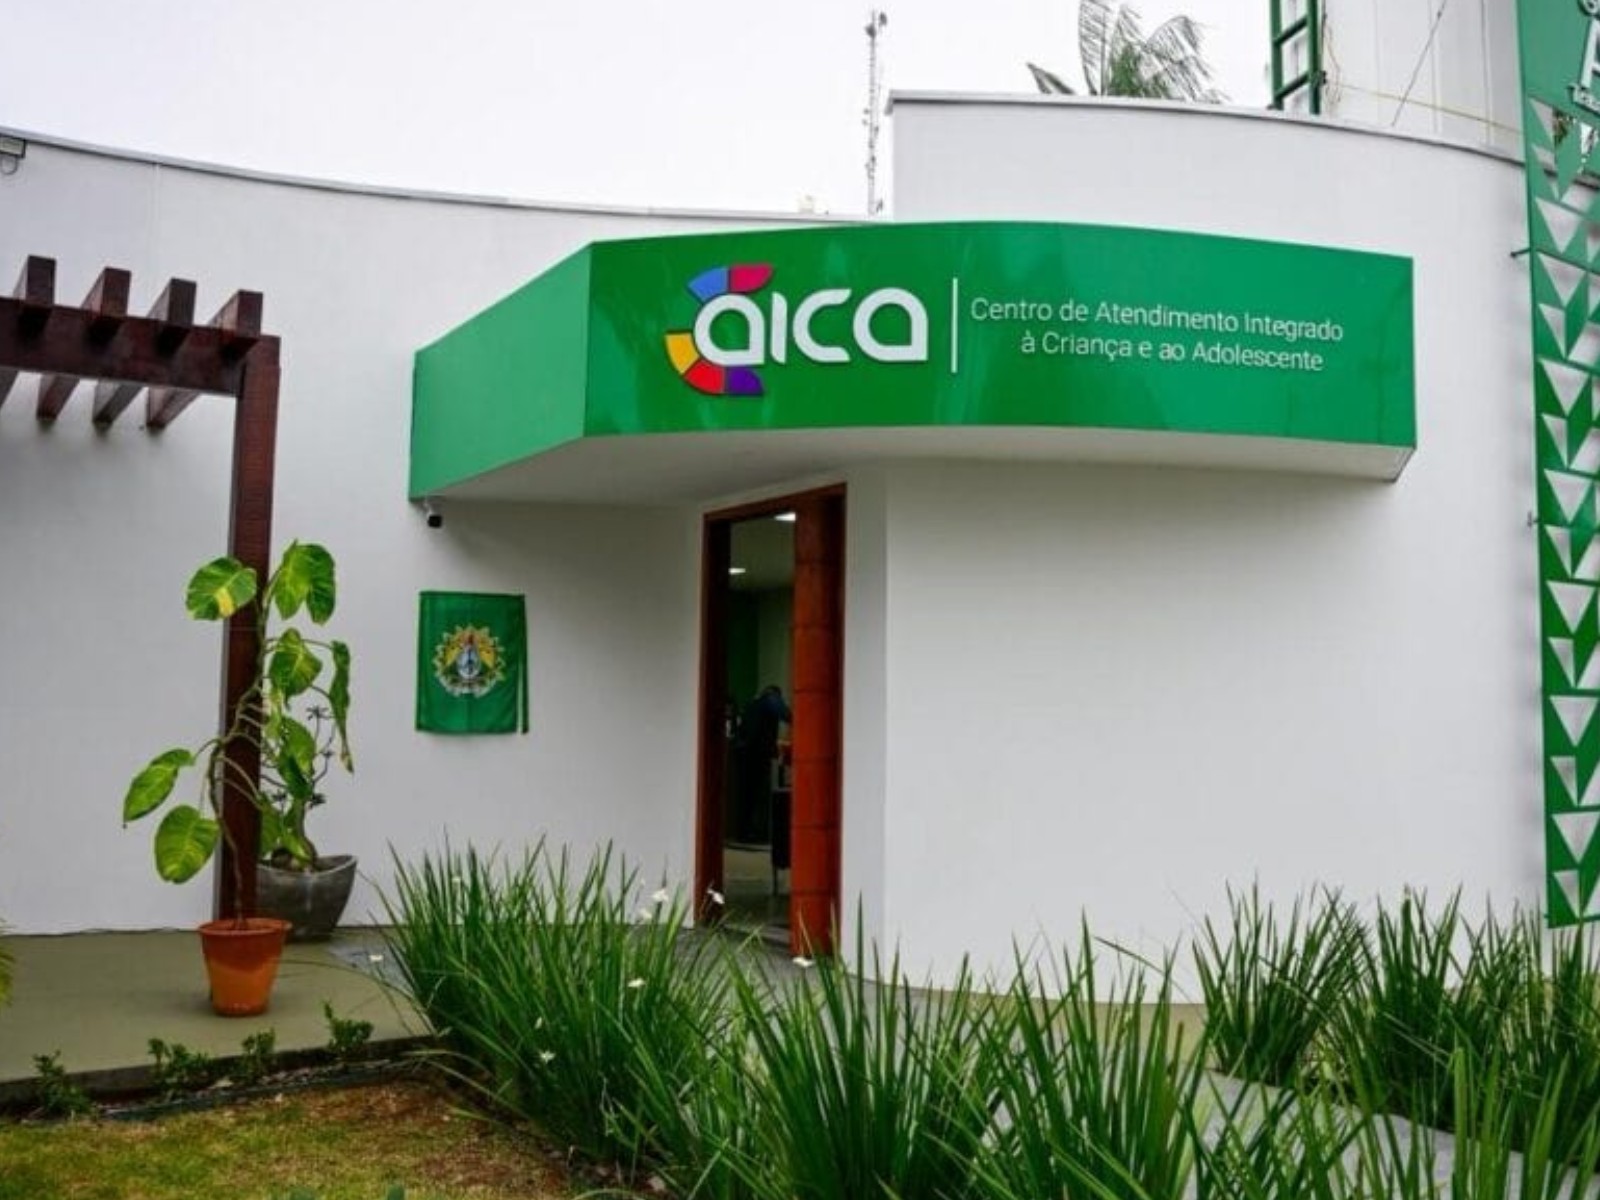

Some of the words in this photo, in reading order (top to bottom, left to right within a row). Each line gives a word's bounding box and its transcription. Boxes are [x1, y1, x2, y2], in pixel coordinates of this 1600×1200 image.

[970, 297, 1053, 321] Centro
[1059, 299, 1089, 322] de
[1095, 301, 1239, 333] Atendimento
[1244, 311, 1343, 342] Integrado
[1021, 330, 1036, 354] à
[1042, 331, 1132, 362] Criança
[1138, 341, 1152, 358] e
[1159, 343, 1185, 361] ao
[1192, 341, 1324, 371] Adolescente
